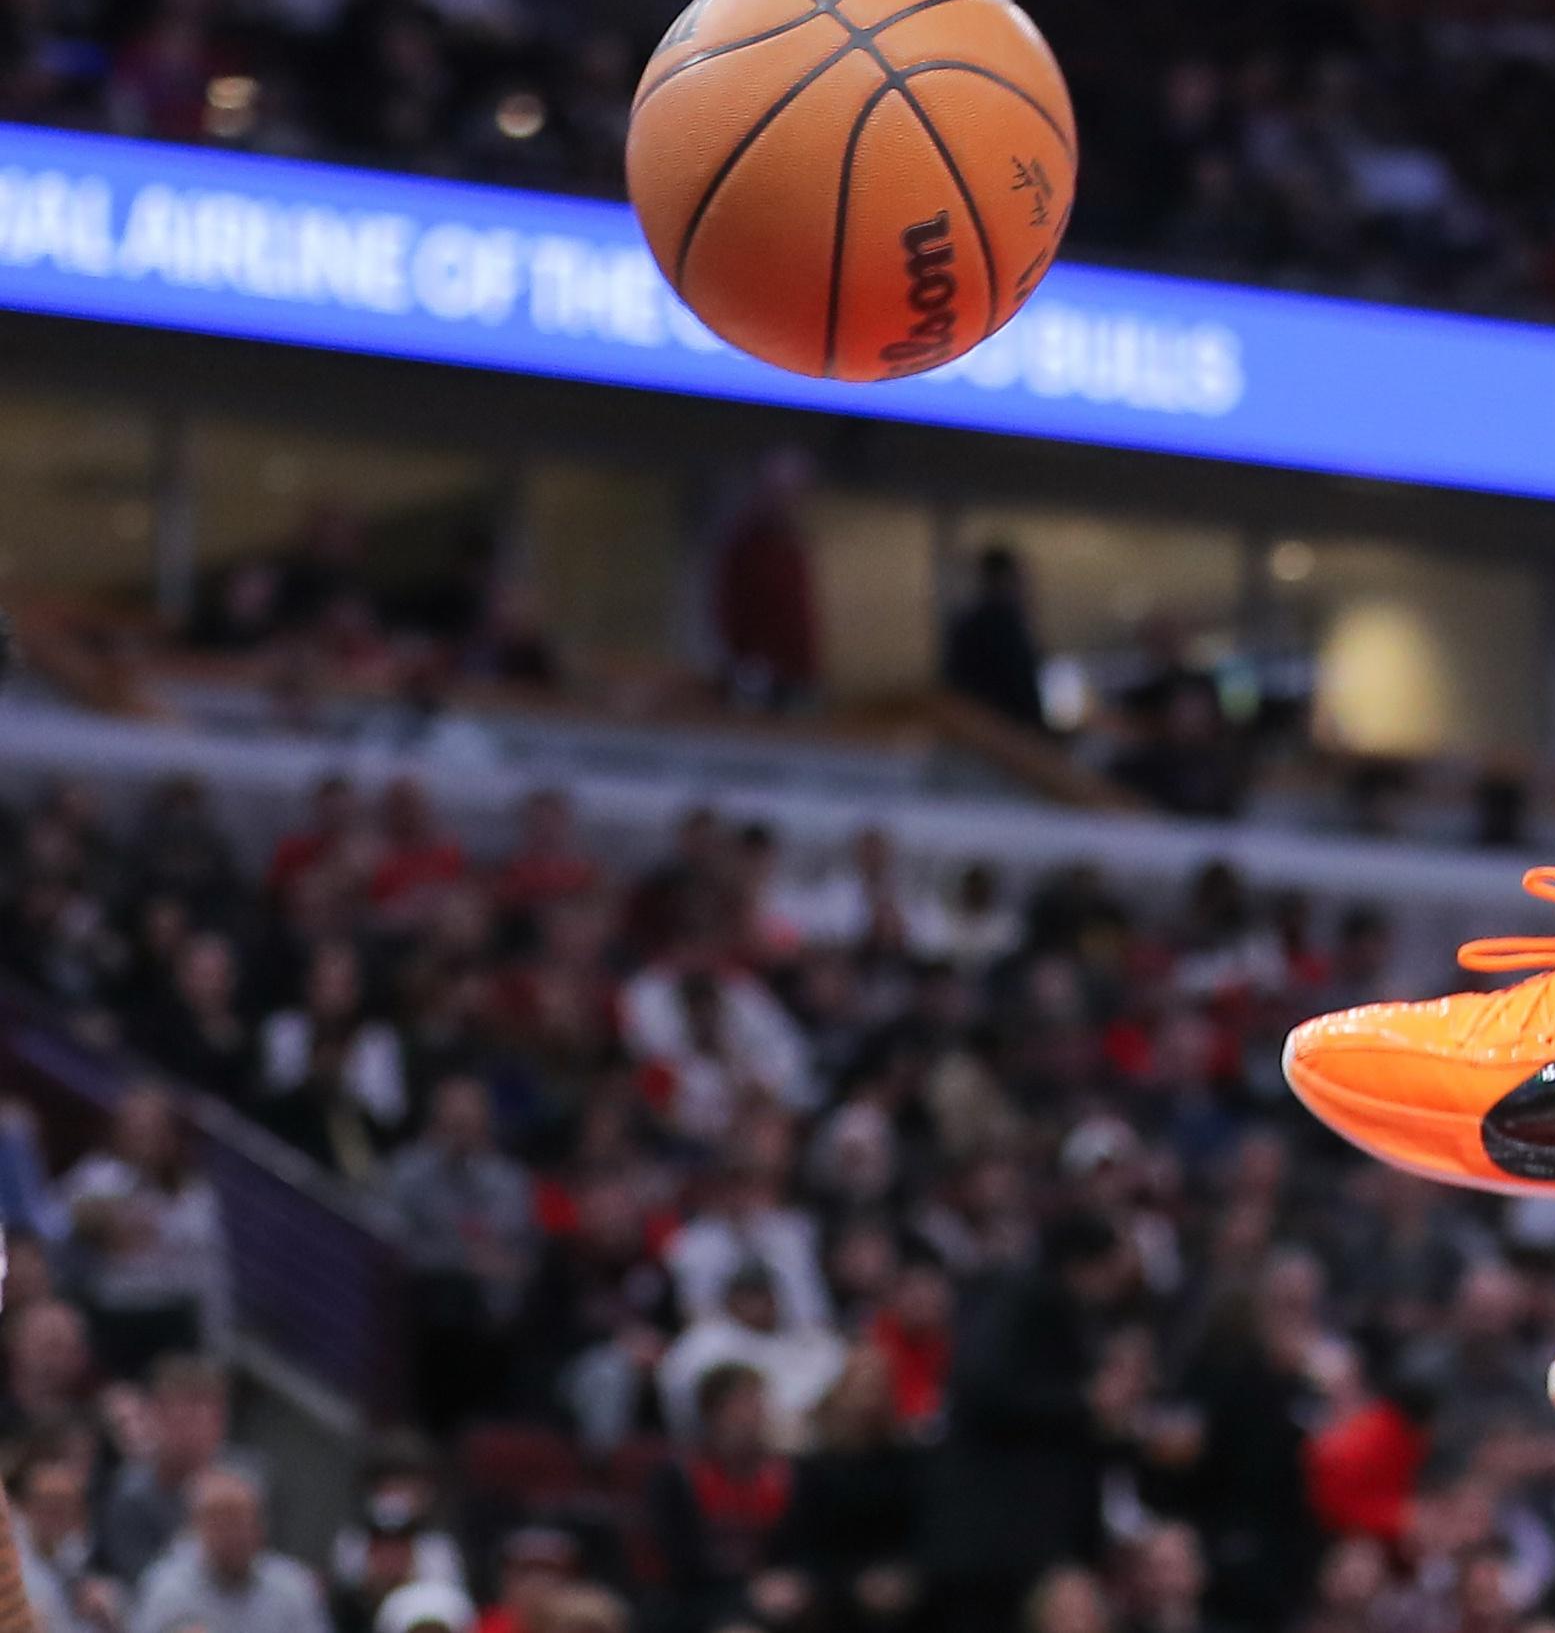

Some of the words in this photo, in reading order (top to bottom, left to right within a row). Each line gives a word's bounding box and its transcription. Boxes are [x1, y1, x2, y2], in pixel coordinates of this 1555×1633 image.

[114, 184, 412, 312] AIRLINE
[411, 223, 522, 323] OF
[525, 234, 668, 349] THE
